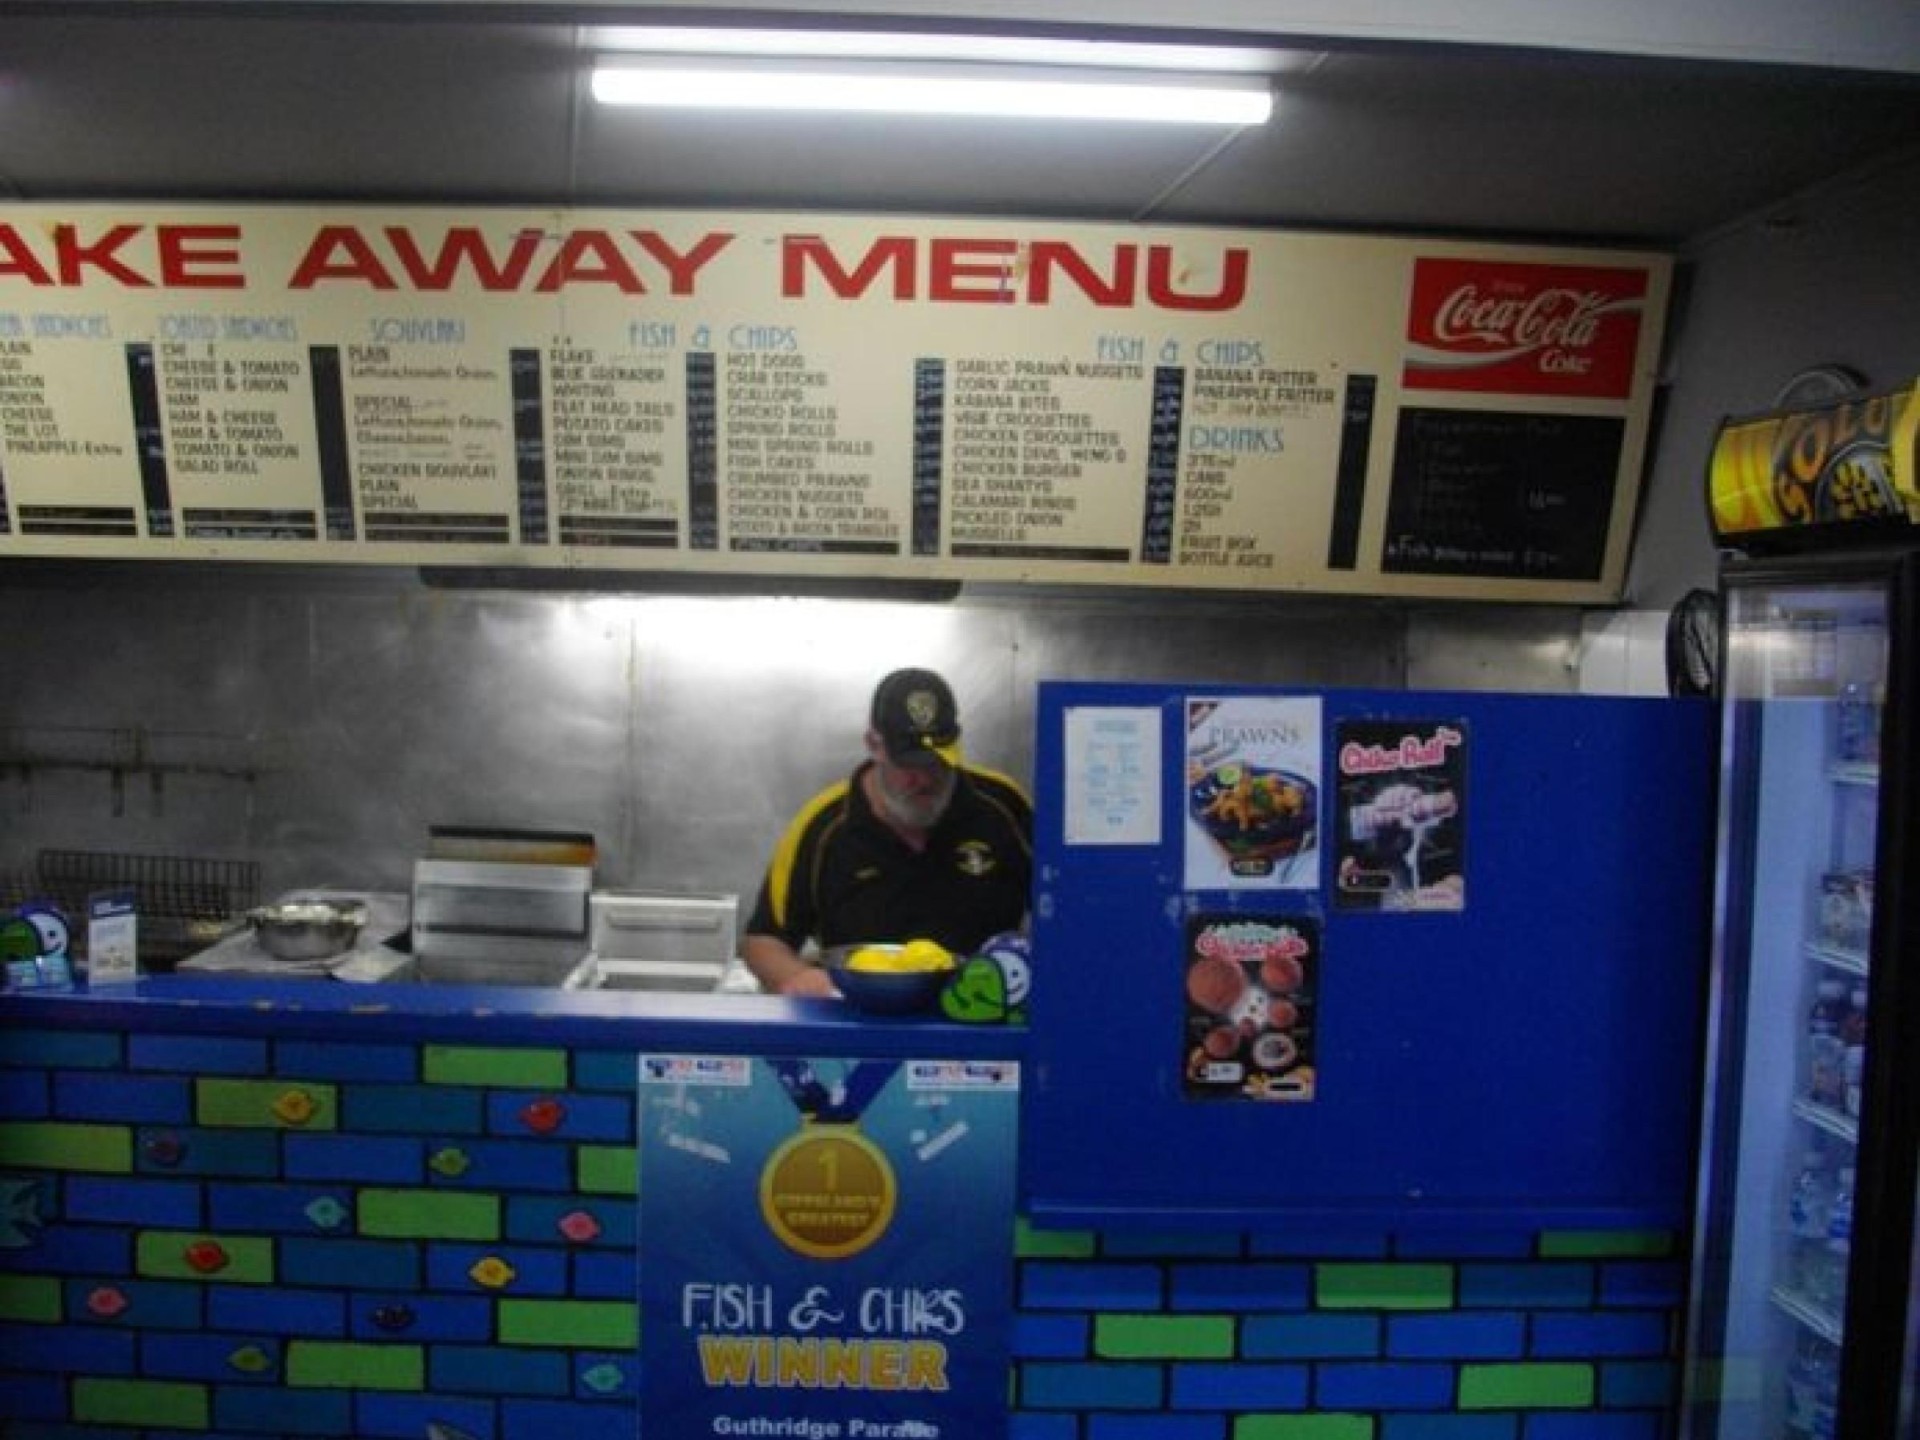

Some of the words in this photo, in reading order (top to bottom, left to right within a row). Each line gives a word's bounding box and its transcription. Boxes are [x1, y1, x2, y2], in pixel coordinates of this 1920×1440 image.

[288, 224, 735, 295] AWAY
[781, 233, 1249, 312] MENU
[628, 321, 676, 348] FISH
[728, 325, 798, 352] CHIPS
[0, 341, 31, 355] LAIN
[348, 344, 390, 361] PLAIN
[1097, 335, 1145, 362] FISH
[1197, 339, 1265, 366] CHIPS
[163, 359, 217, 374] CHEESE
[224, 360, 235, 375] &
[241, 360, 299, 375] TOMATO
[727, 352, 756, 367] HOT
[1538, 349, 1593, 374] Coke
[956, 359, 1011, 375] GARLIC
[1075, 362, 1144, 380] NUGGETS
[1195, 368, 1253, 383] BANANA
[1258, 370, 1318, 387] FRITTER
[166, 376, 217, 391] CHEESE
[225, 377, 236, 391] &
[243, 378, 288, 392] ONION
[728, 370, 767, 384] CRAB
[774, 371, 828, 386] STICKS
[956, 376, 1000, 391] CORN
[167, 393, 199, 405] HAM
[728, 387, 803, 402] SCALLOPS
[1192, 384, 1271, 401] PINEAPPLE
[1276, 387, 1336, 404] FRITTER
[2, 407, 53, 422] CHEESE
[553, 400, 584, 413] FLAT
[591, 401, 631, 415] HEAD
[791, 406, 838, 420] ROLLS
[169, 410, 201, 423] HAM
[207, 411, 217, 424] &
[224, 410, 277, 425] CHEESE
[553, 416, 610, 430] POTATO
[616, 418, 664, 432] CAKES
[996, 412, 1092, 428] CROQUETTES
[5, 423, 27, 437] THE
[171, 426, 203, 439] HAM
[209, 427, 219, 440] &
[226, 427, 283, 441] TOMATO
[788, 423, 836, 437] ROLLS
[954, 428, 1019, 442] CHICKEN
[1023, 430, 1121, 446] CROQUETTES
[1188, 425, 1285, 453] DRINKS
[174, 443, 230, 457] TOMATO
[237, 444, 247, 457] &
[253, 444, 299, 458] ONION
[826, 440, 874, 456] ROLLS
[953, 445, 1018, 460] CHICKEN
[175, 459, 219, 473] SALAD
[224, 460, 258, 474] ROLL
[728, 454, 761, 467] FISH
[767, 455, 815, 469] CAKES
[952, 462, 1018, 476] CHICKEN
[359, 463, 421, 478] CHICKEN
[426, 463, 496, 479] SOUVLAKI
[728, 471, 800, 486] CRUMBED
[1186, 471, 1226, 484] CANS
[359, 480, 399, 493] PLAIN
[952, 478, 980, 491] SEA
[361, 495, 418, 509] SPECIAL
[728, 487, 792, 502] CHICKEN
[797, 489, 864, 505] NUGGETS
[728, 503, 792, 518] CHICKEN
[798, 505, 808, 519] &
[815, 506, 858, 521] CORN
[1180, 534, 1221, 549] FRUIT
[1178, 551, 1230, 567] BOTTLE
[1207, 724, 1301, 747] PRAWNS
[818, 1148, 839, 1191] 1
[682, 1282, 773, 1330] FISH
[788, 1284, 845, 1331] &
[698, 1334, 950, 1391] WINNER
[712, 1415, 840, 1440] Guthridge
